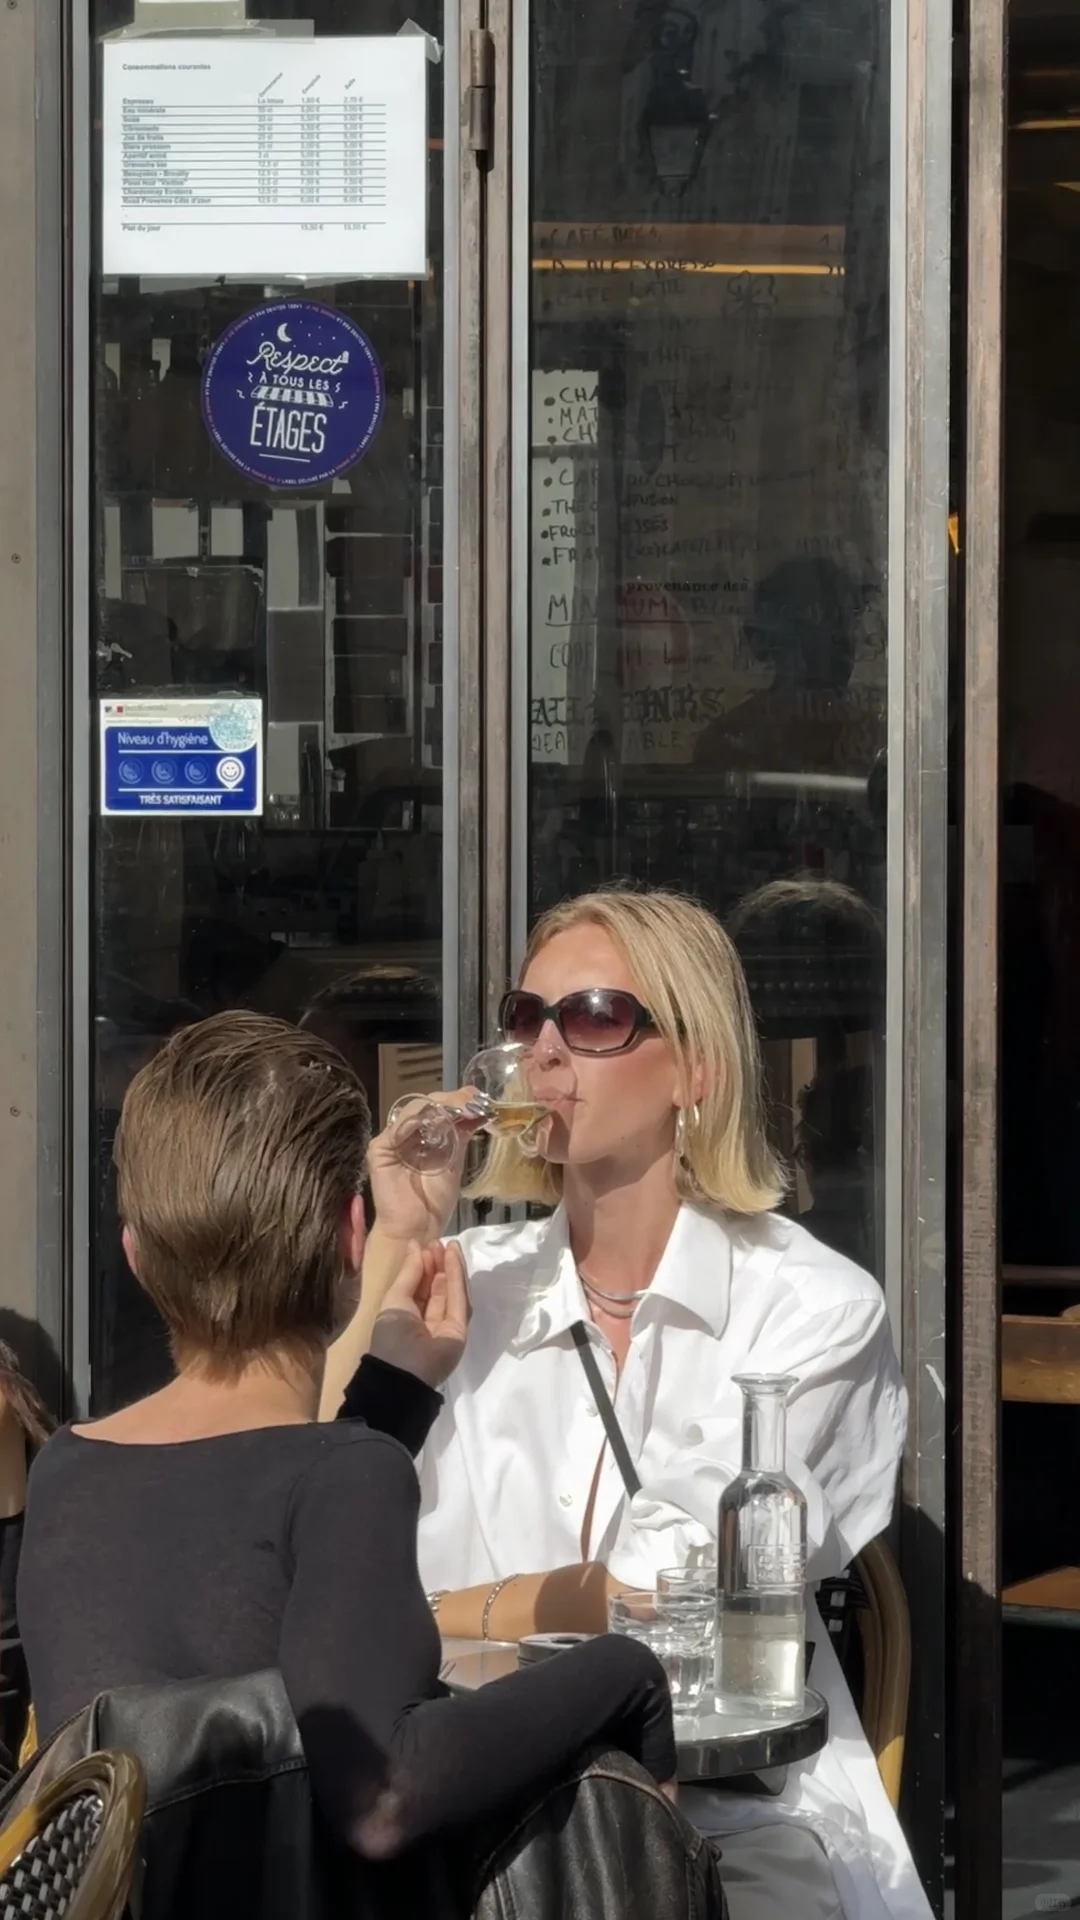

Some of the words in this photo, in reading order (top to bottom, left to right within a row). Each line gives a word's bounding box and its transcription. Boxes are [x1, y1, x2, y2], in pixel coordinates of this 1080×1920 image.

[246, 341, 350, 376] Respect
[273, 374, 304, 388] TOUS
[309, 378, 330, 391] LES
[250, 402, 327, 454] ÉTAGES
[118, 732, 155, 745] Niveau
[157, 732, 208, 748] d'hygiène
[164, 795, 222, 805] SATISFAISANT
